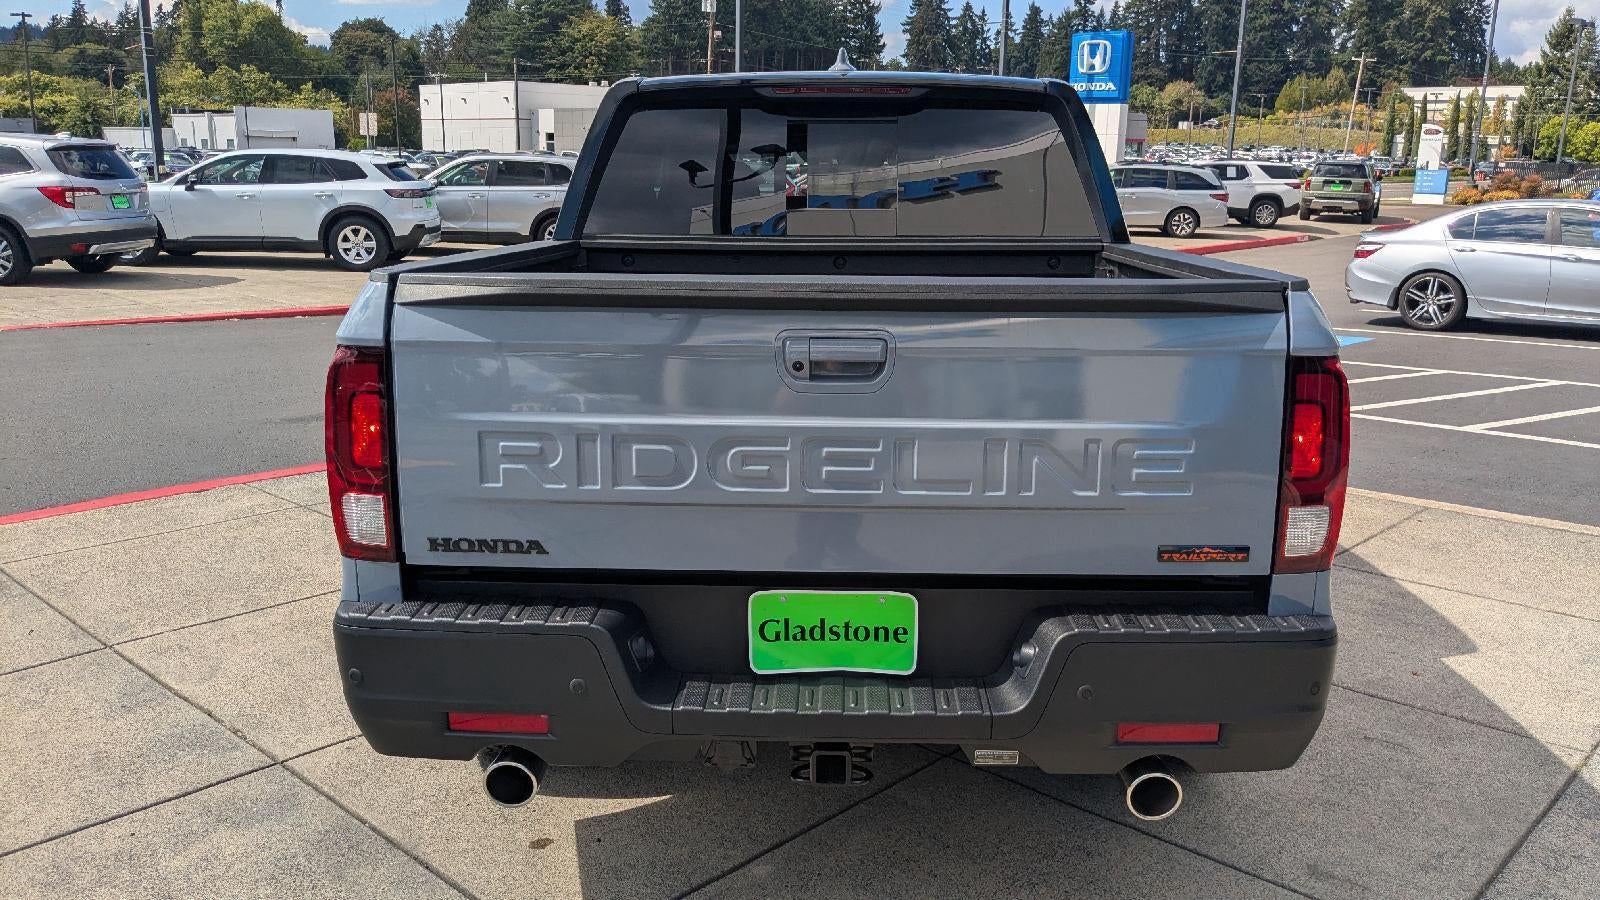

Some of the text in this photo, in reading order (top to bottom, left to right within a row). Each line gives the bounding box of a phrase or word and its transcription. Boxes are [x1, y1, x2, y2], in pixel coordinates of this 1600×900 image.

[477, 429, 1196, 497] RIDGELINE
[427, 537, 549, 554] HONDA
[1160, 551, 1248, 562] TRAILSPORT
[758, 618, 909, 643] Gladstone
